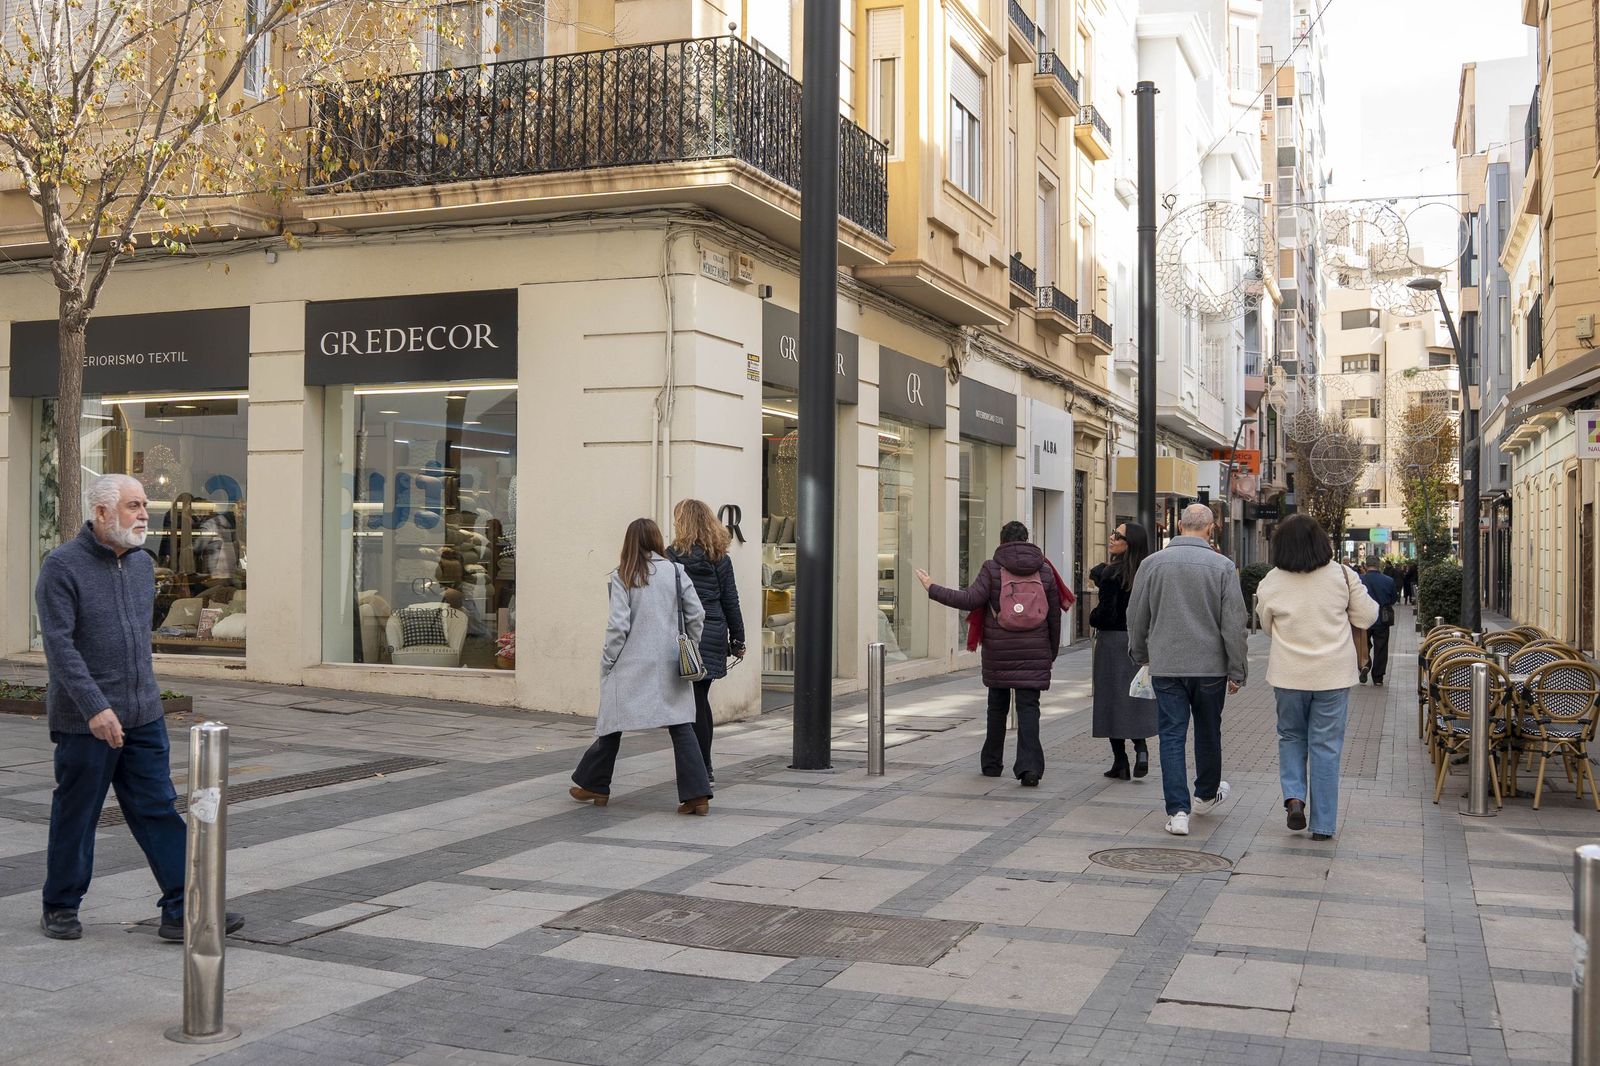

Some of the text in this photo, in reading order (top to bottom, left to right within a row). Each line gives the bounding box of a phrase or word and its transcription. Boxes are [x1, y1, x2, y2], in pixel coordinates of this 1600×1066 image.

[320, 323, 500, 356] GREDECOR
[83, 351, 188, 367] ERIORISMO TEXTIL
[1042, 440, 1057, 454] ALBA
